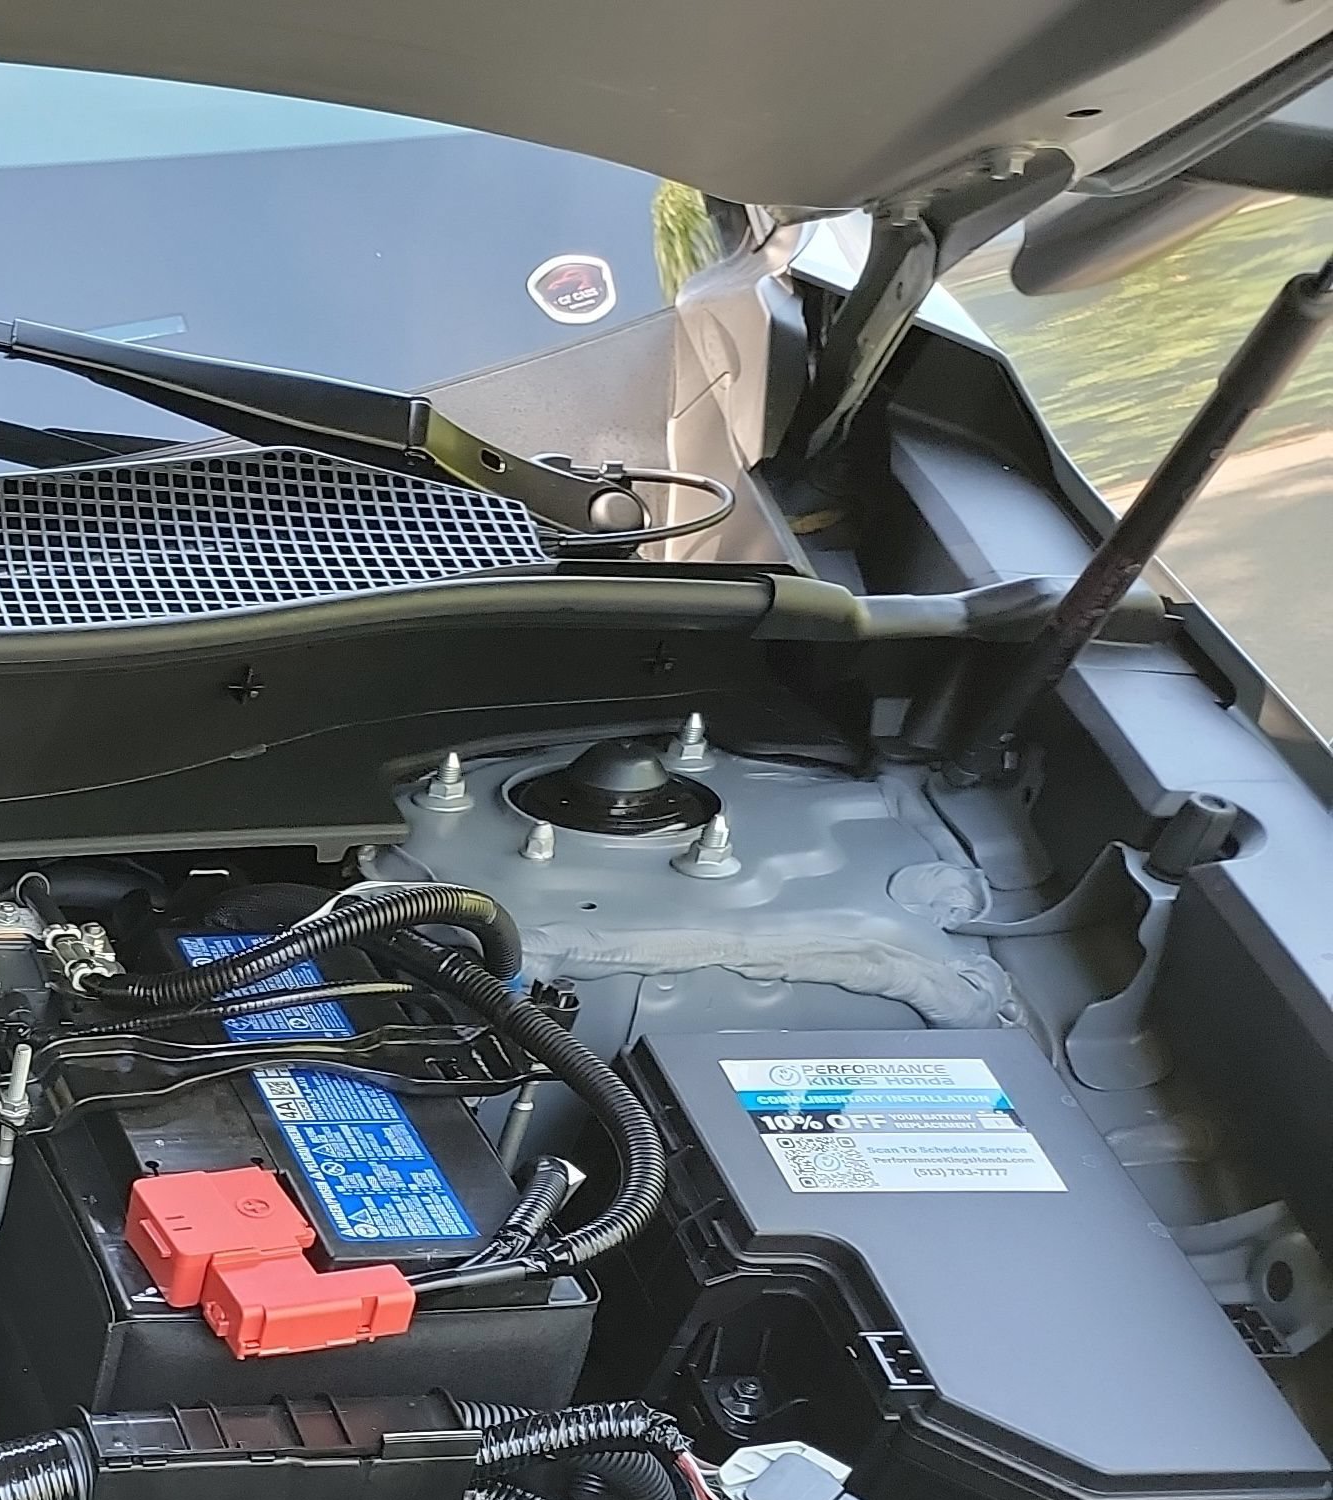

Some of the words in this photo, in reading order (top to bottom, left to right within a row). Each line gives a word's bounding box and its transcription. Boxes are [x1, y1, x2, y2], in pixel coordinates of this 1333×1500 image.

[802, 1064, 948, 1075] PERFORMANCE
[807, 1076, 878, 1086] KINGS
[886, 1076, 955, 1086] Honda
[756, 1094, 885, 1105] COMPLIMENTARY
[886, 1094, 991, 1105] INSTALLATION
[282, 1101, 299, 1119] 4A
[889, 1113, 921, 1121] YOUR
[758, 1114, 824, 1131] 10%
[826, 1114, 887, 1130] OFF
[893, 1122, 978, 1130] REPLACEMENT
[867, 1146, 900, 1154] Scan
[904, 1146, 918, 1154] To
[919, 1146, 978, 1154] Schedule
[979, 1146, 1028, 1154] Service
